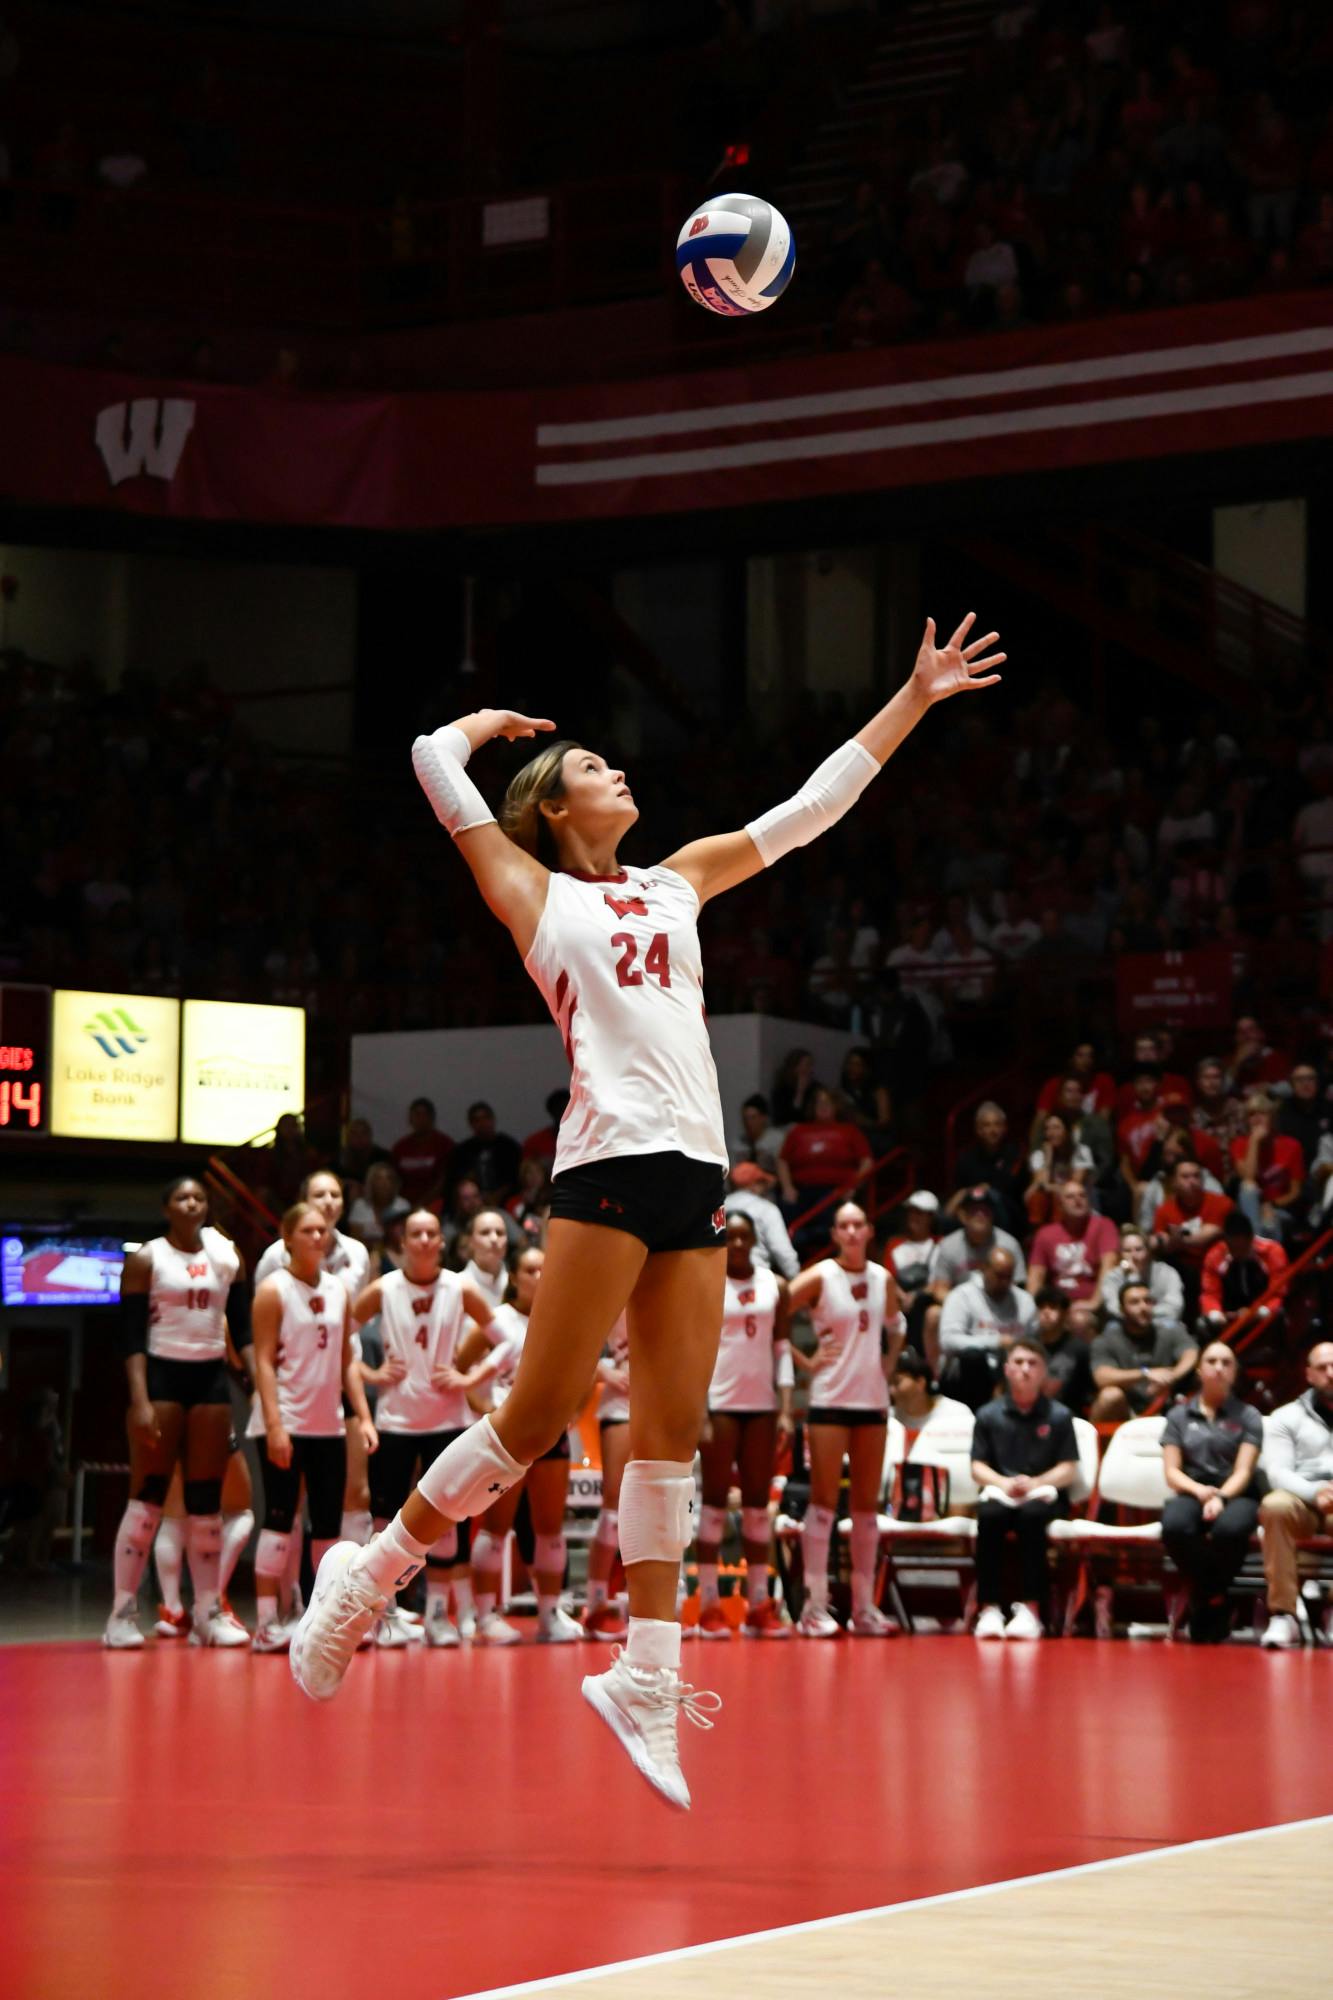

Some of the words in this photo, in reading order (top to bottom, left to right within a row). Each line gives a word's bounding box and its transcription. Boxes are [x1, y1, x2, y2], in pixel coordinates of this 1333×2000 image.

[95, 398, 196, 486] W
[610, 931, 672, 988] 24
[64, 1066, 106, 1083] Lake
[112, 1068, 165, 1088] Ridge
[0, 1080, 41, 1127] 14
[91, 1090, 136, 1106] Bank
[317, 1324, 329, 1350] 3
[415, 1324, 429, 1350] 4
